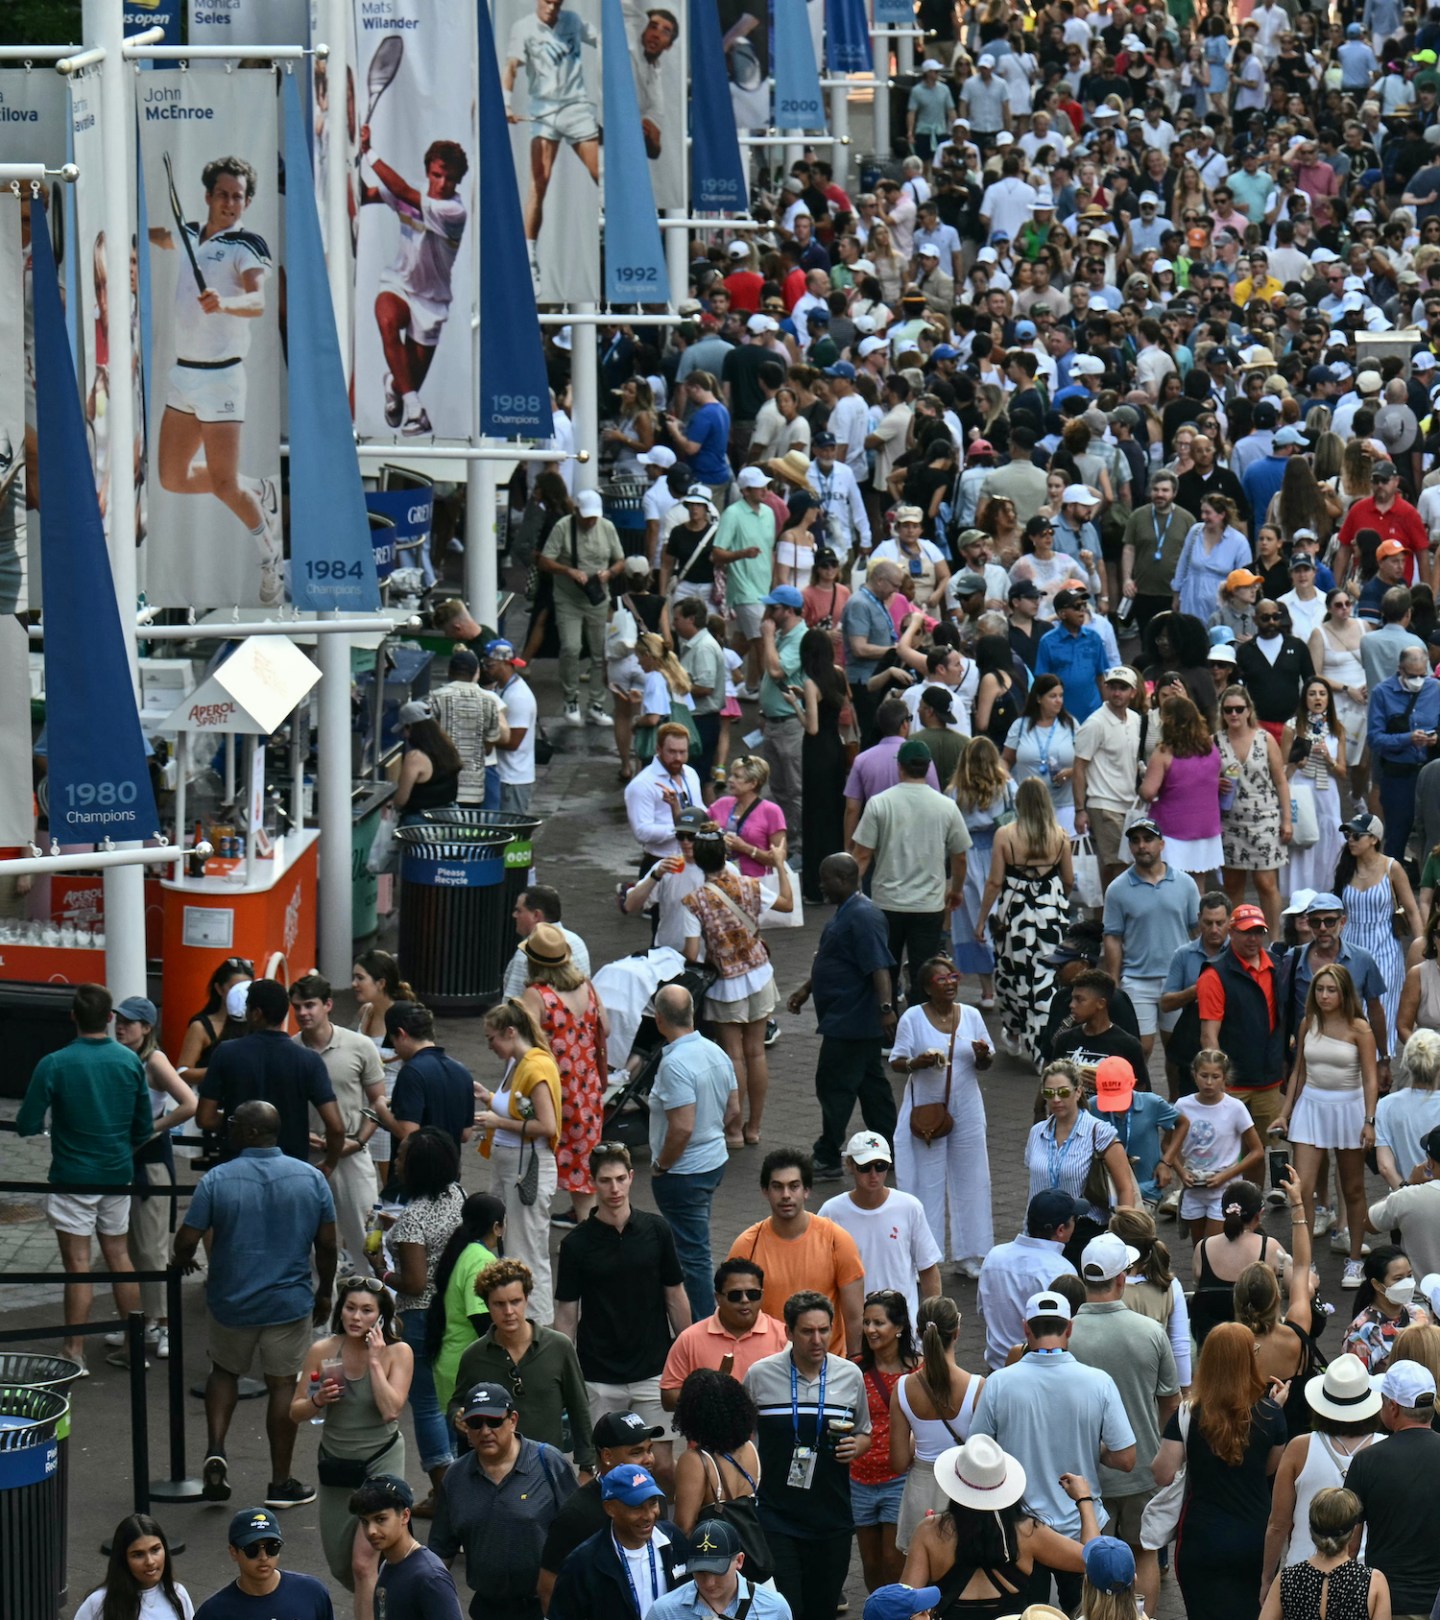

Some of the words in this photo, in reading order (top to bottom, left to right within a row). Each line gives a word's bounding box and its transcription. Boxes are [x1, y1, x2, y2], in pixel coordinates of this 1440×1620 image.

[362, 2, 393, 14] Mats
[195, 11, 232, 24] Seles
[363, 17, 420, 30] Wilander
[144, 86, 182, 103] John
[145, 104, 215, 121] McEnroe
[781, 100, 819, 112] 2000
[701, 179, 738, 192] 1996
[616, 266, 657, 282] 1992
[491, 394, 541, 412] 1988
[491, 413, 540, 425] Champions
[305, 559, 364, 580] 1984
[305, 582, 363, 596] Champions
[188, 702, 236, 721] APEROL
[196, 714, 228, 728] SPRITZ
[65, 781, 138, 807] 1980
[66, 809, 136, 825] Champions
[437, 867, 466, 878] Please
[434, 875, 469, 886] Recycle
